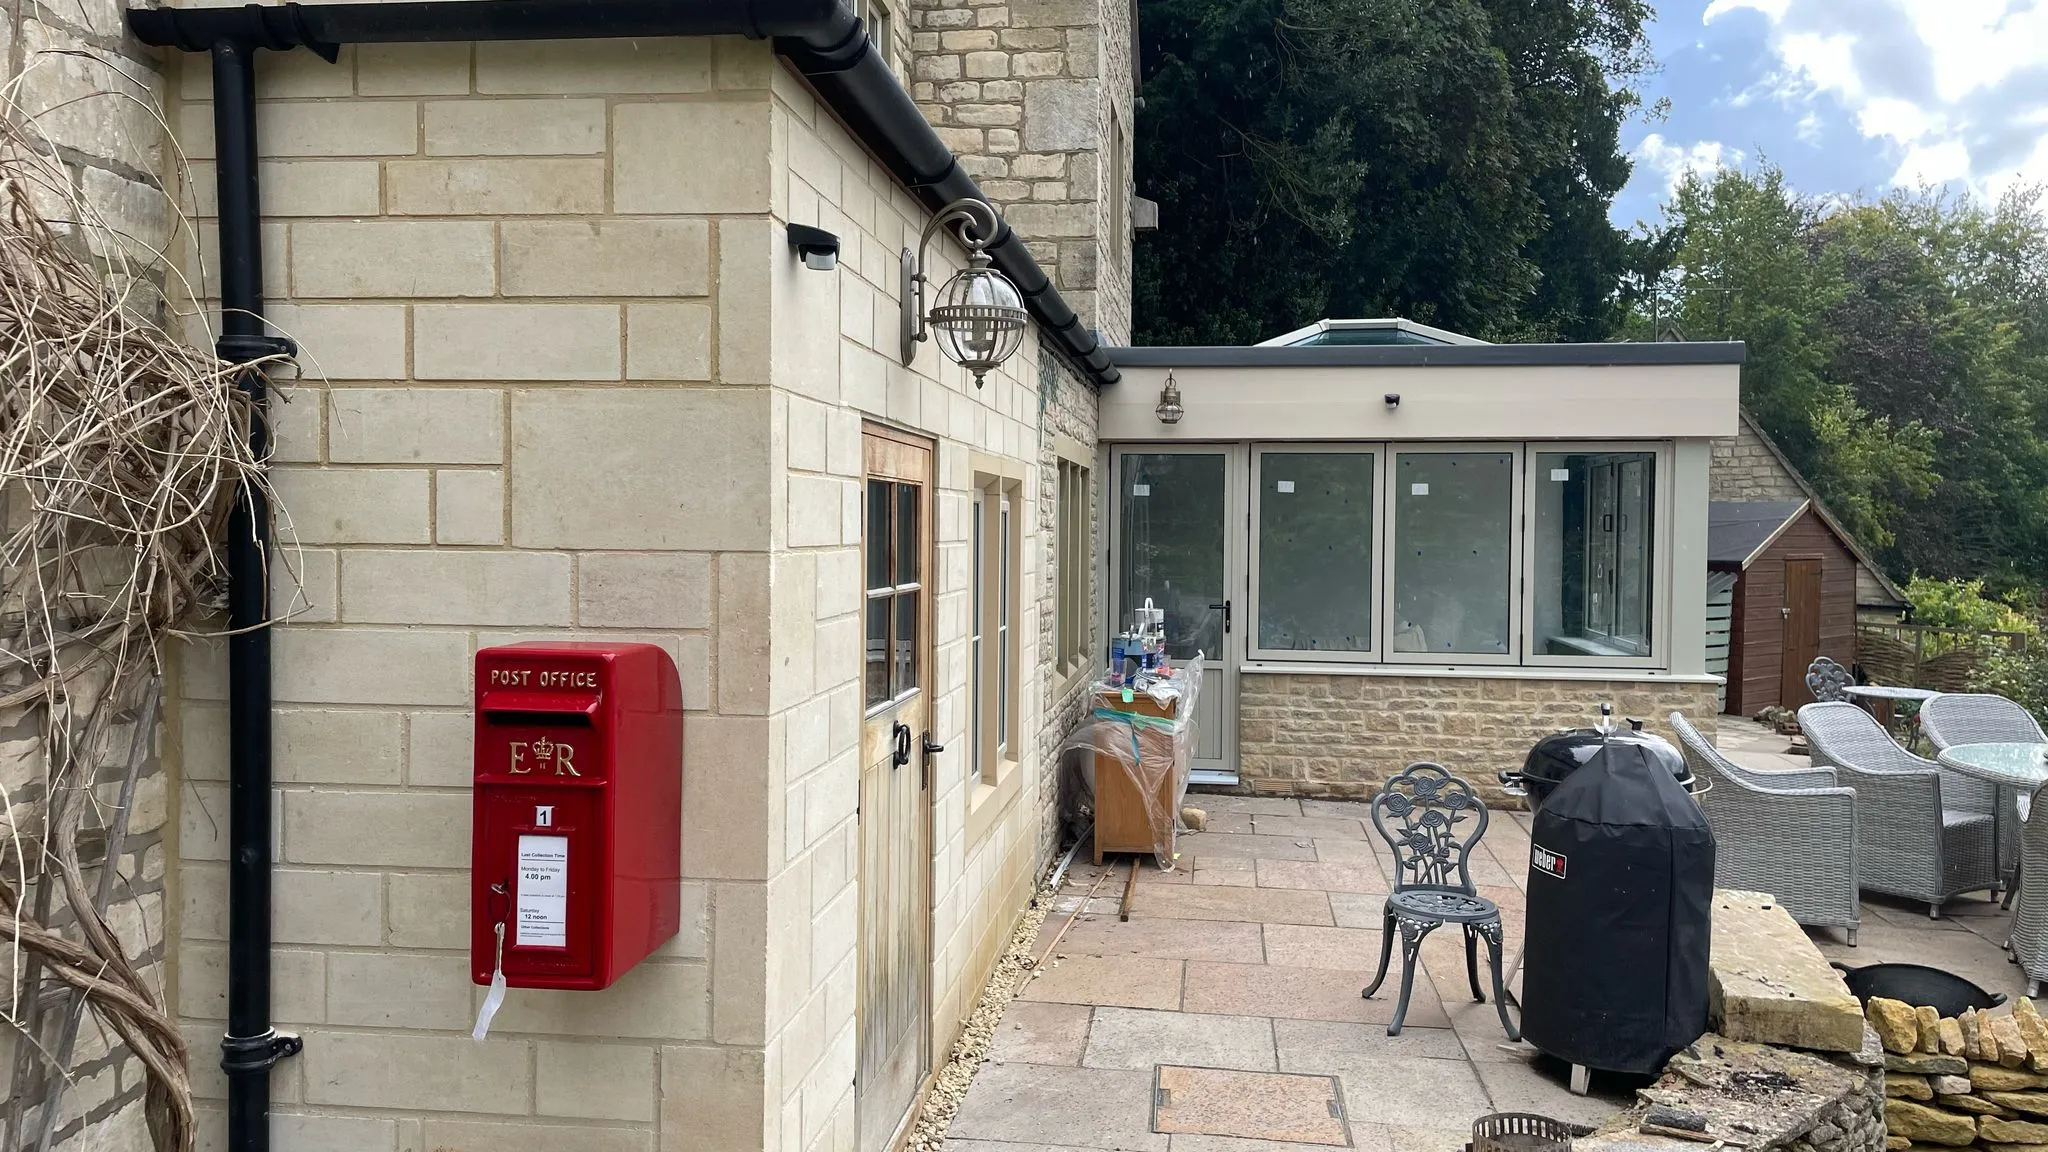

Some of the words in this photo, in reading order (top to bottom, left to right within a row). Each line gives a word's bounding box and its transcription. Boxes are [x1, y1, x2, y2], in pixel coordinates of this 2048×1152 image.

[491, 669, 532, 686] POST
[540, 671, 597, 688] OFFICE
[509, 742, 531, 774] E
[555, 743, 581, 776] R
[539, 810, 547, 825] 1
[1534, 849, 1556, 871] weber
